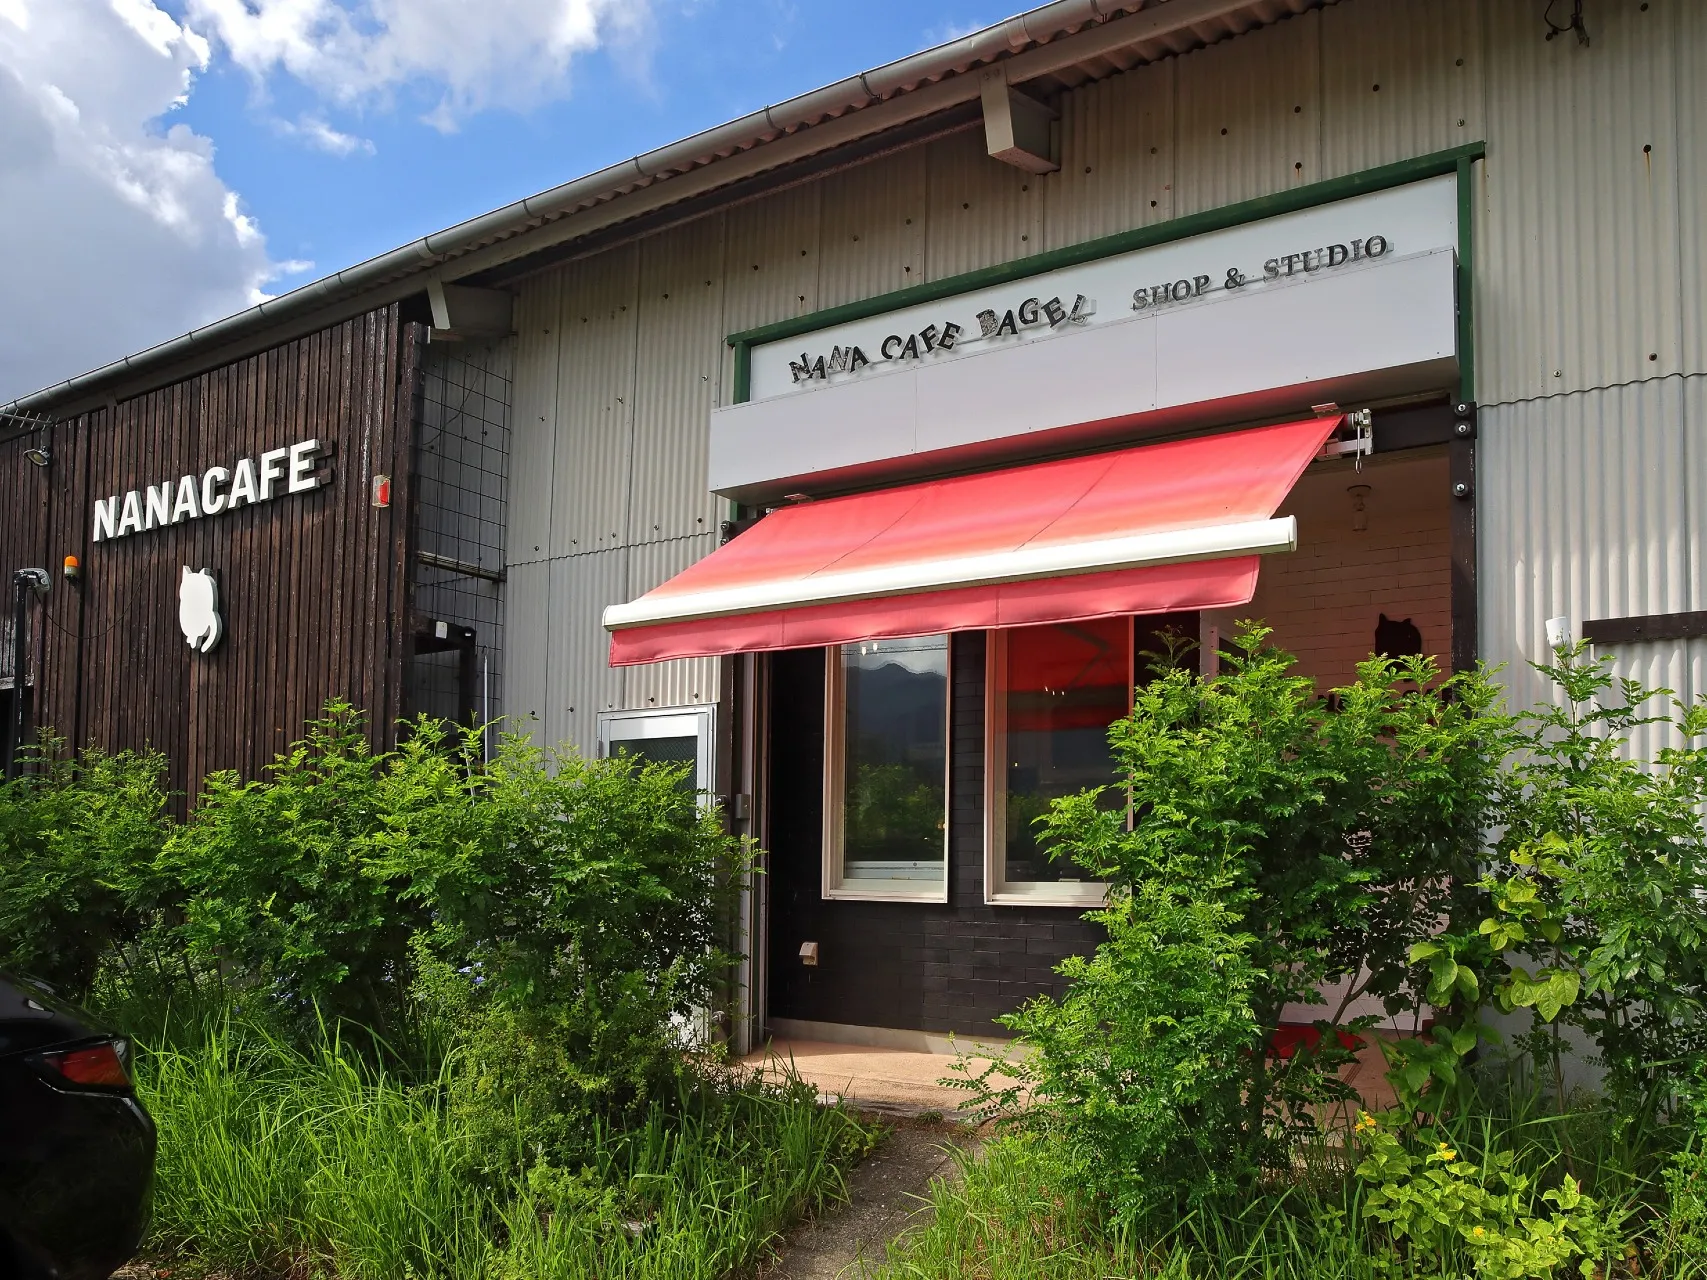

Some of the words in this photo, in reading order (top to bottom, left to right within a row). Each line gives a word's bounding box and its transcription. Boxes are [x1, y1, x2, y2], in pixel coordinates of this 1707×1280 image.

[789, 345, 869, 384] NANA
[881, 321, 961, 359] CAFE
[976, 294, 1089, 335] BAGEL
[1133, 274, 1211, 310] SHOP
[1225, 267, 1245, 290] &
[1263, 235, 1388, 279] STUDIO
[93, 439, 320, 542] NANACAFE
